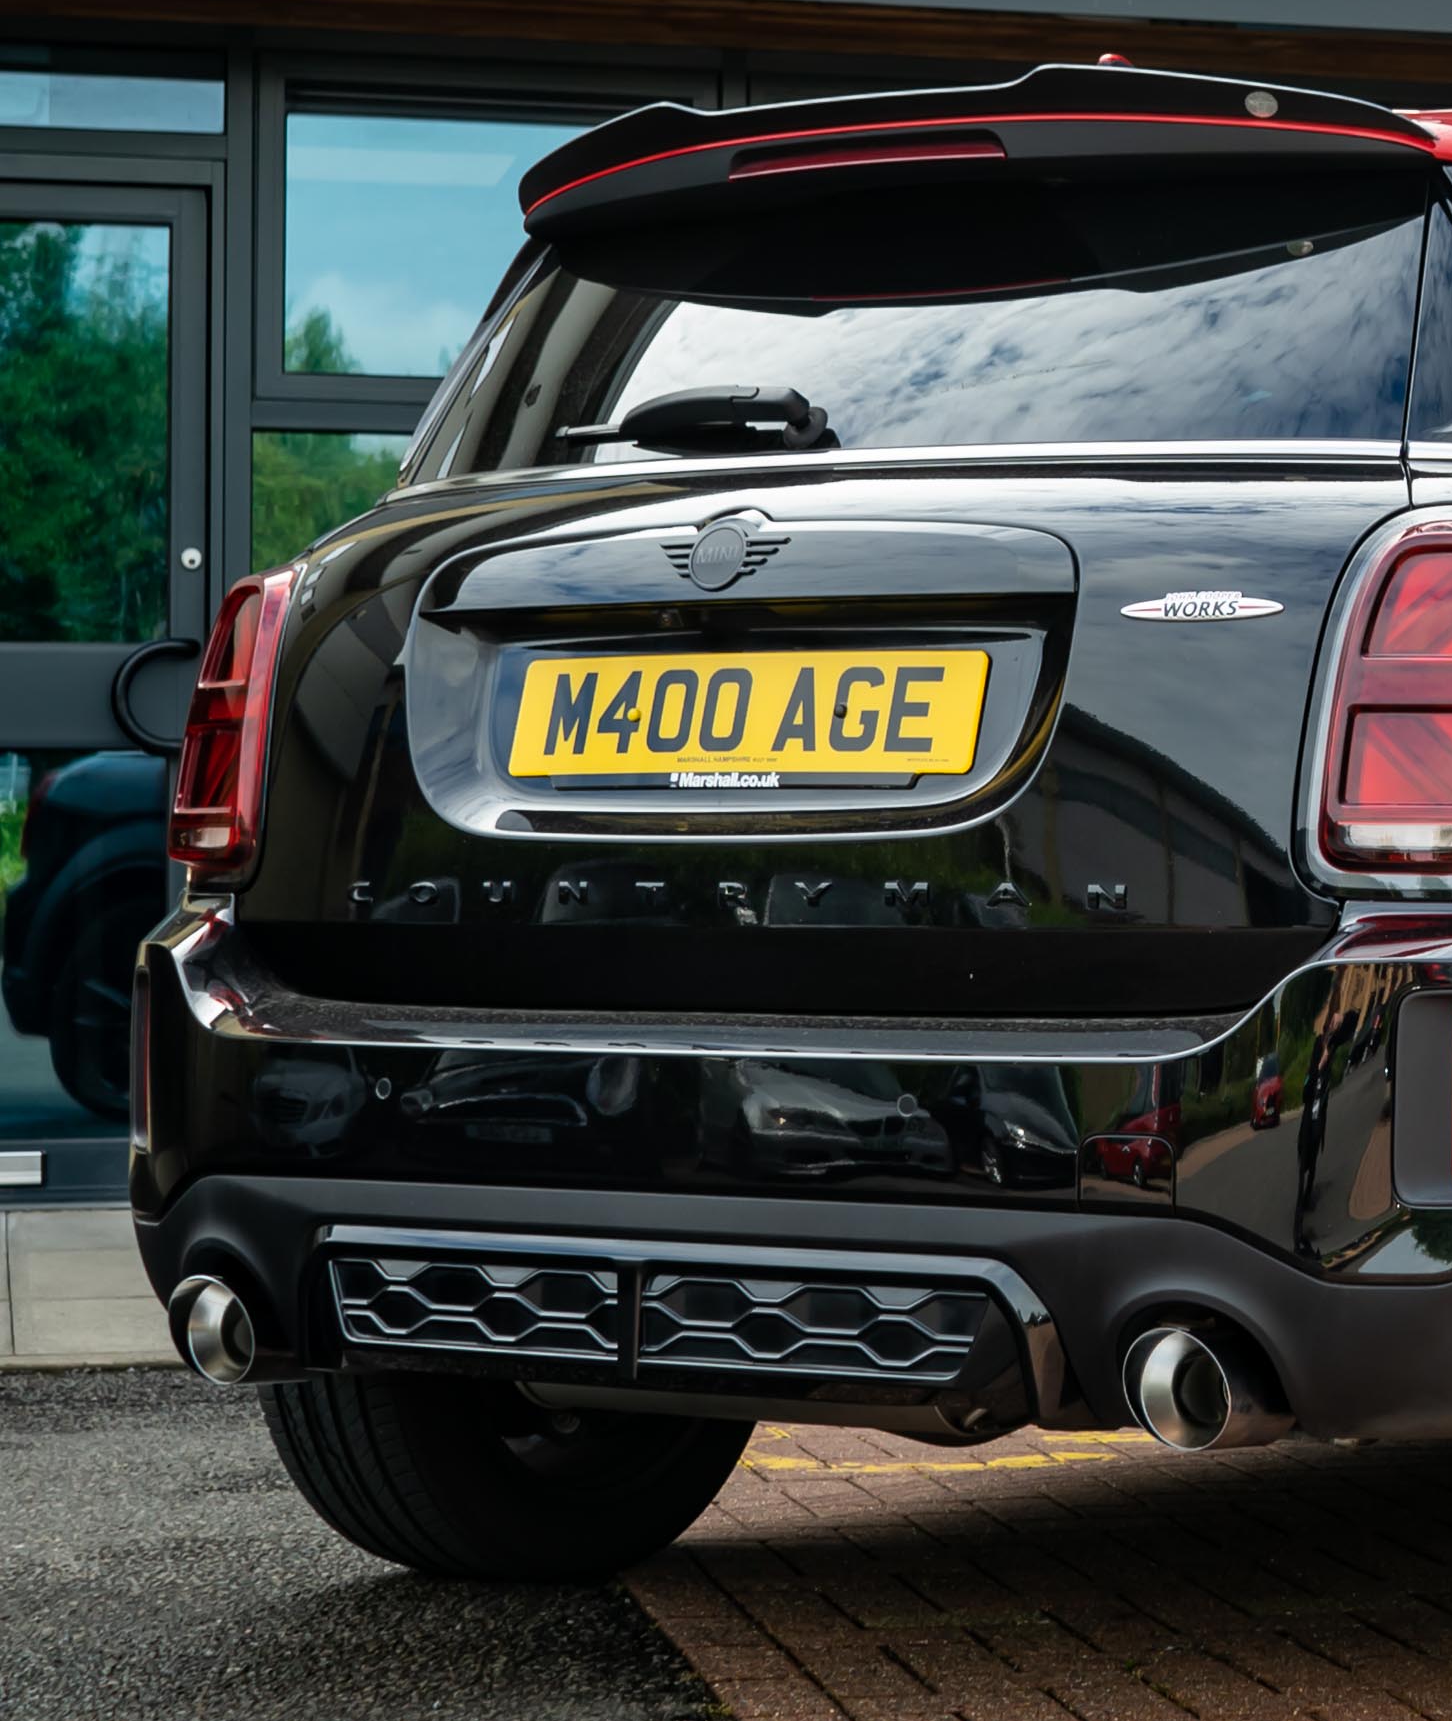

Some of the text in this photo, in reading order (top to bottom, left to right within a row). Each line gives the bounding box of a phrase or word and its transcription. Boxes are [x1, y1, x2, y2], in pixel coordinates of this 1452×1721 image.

[696, 545, 738, 565] MINI
[1197, 591, 1242, 600] COOPER
[1163, 600, 1239, 617] WORKS
[543, 666, 946, 755] M400 AGE
[679, 772, 780, 788] Marshall.co.uk
[348, 880, 1129, 912] COUNTRYMAN
